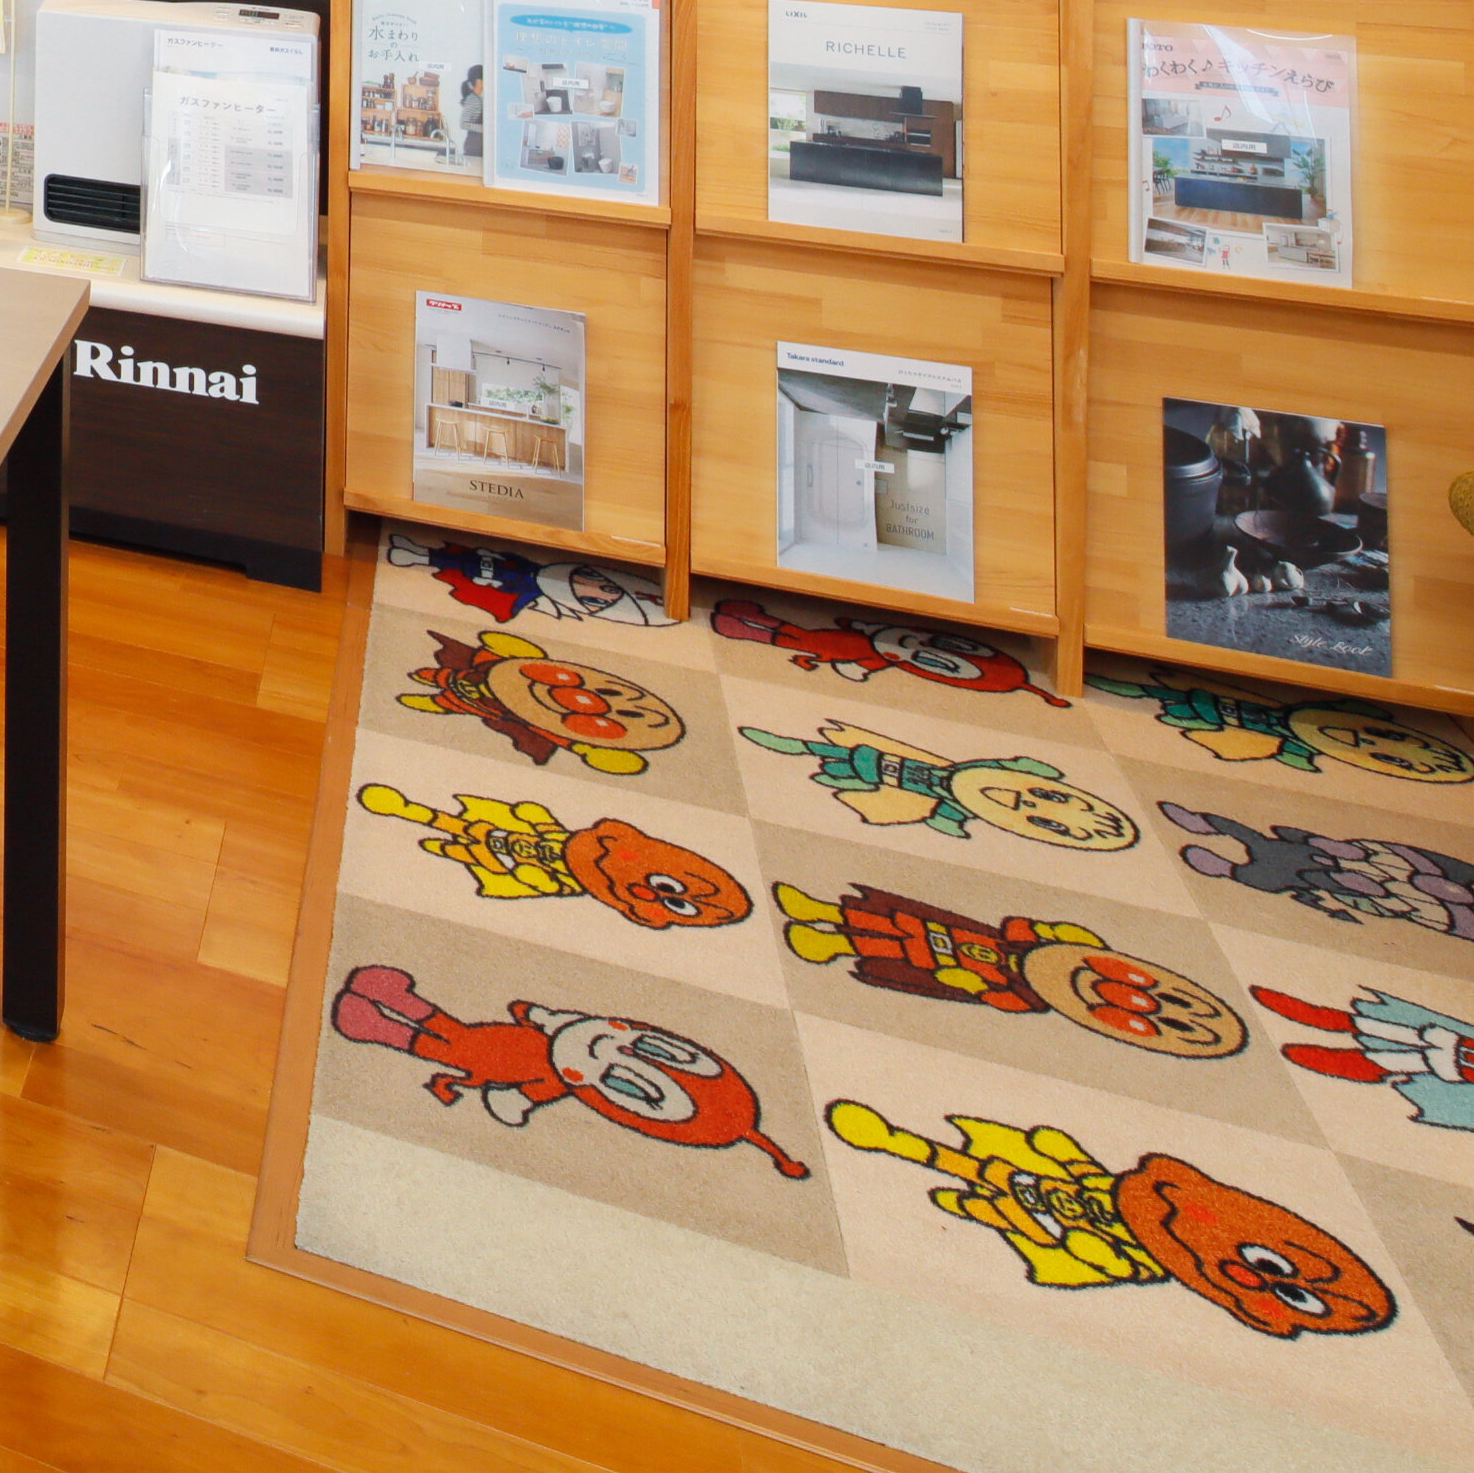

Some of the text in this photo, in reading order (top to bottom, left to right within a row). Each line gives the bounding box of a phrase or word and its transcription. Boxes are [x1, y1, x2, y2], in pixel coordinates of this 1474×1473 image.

[785, 11, 808, 19] LIXIL
[368, 25, 419, 43] 水まわり
[166, 38, 224, 48] ガスファンヒーター
[390, 41, 398, 49] の
[825, 40, 908, 60] RICHELLE
[368, 48, 420, 63] お手入れ
[179, 95, 278, 114] ガスファンヒーター
[786, 352, 845, 368] Takara standard
[73, 339, 260, 405] Rinnai
[469, 479, 525, 500] STEDIA
[890, 498, 931, 516] Justsize
[906, 515, 919, 525] for
[884, 522, 935, 541] BATHROOM
[1330, 640, 1374, 656] Book
